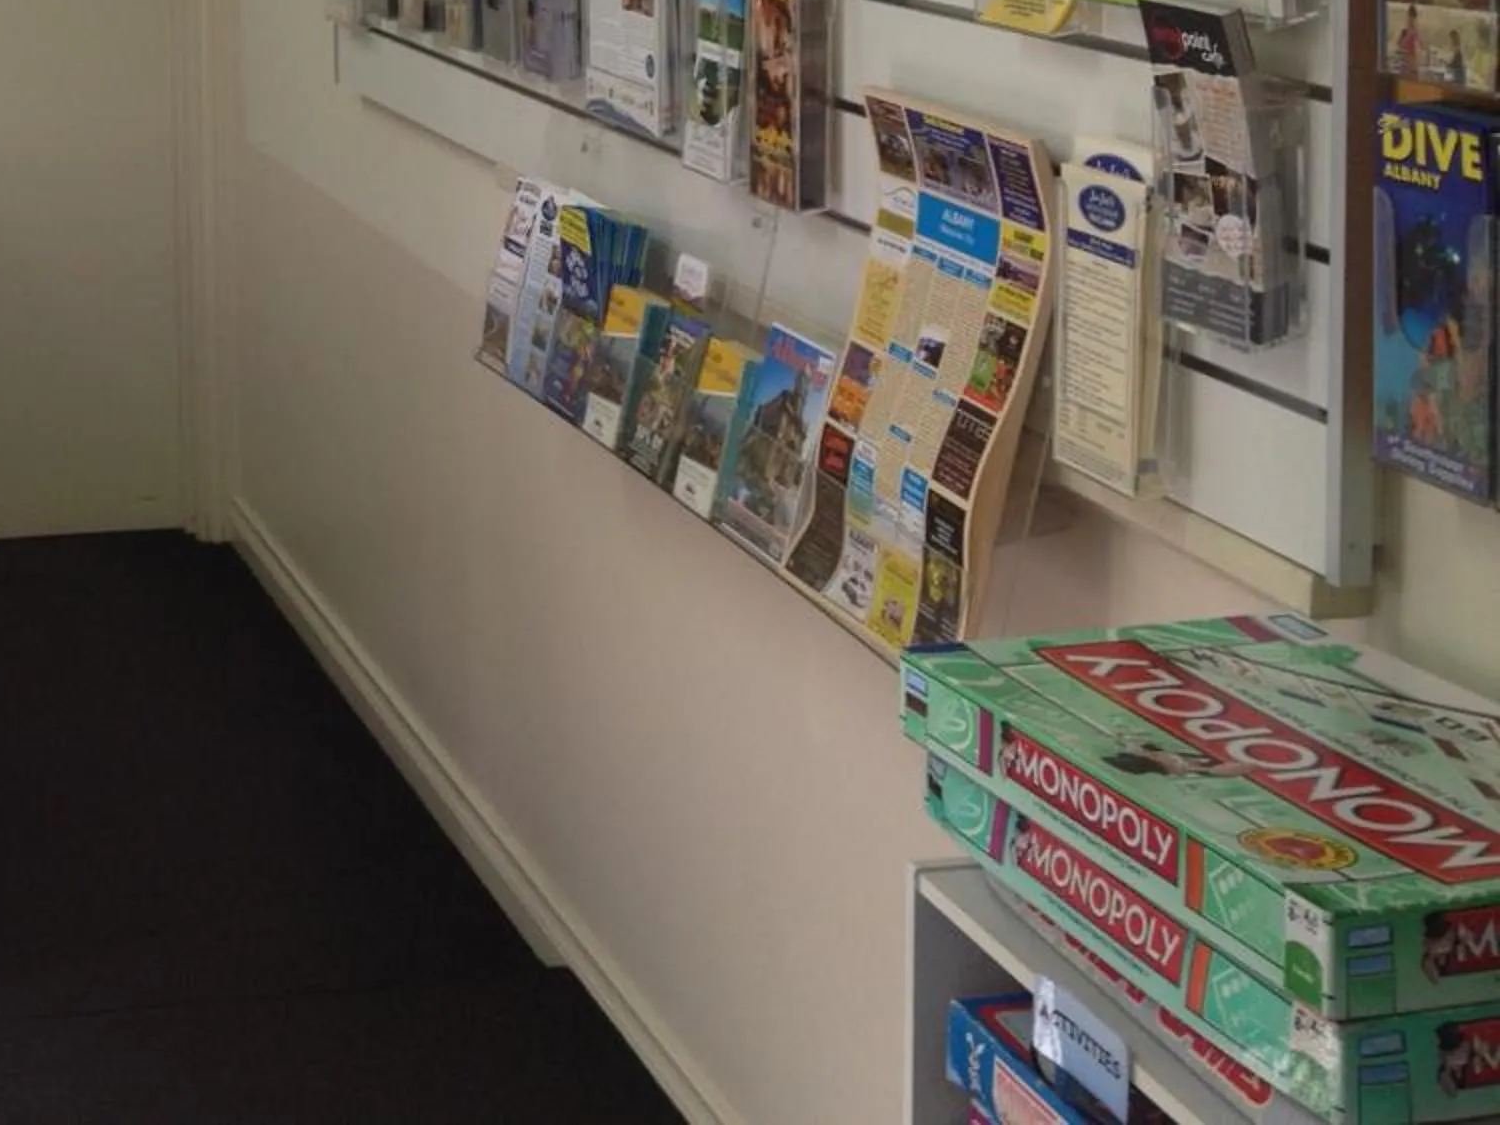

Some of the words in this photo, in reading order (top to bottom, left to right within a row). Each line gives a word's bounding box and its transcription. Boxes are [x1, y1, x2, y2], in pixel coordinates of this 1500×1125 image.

[1382, 119, 1484, 182] DIVE
[1016, 742, 1174, 866] MONOPOLY
[1027, 832, 1181, 967] MONOPOLY
